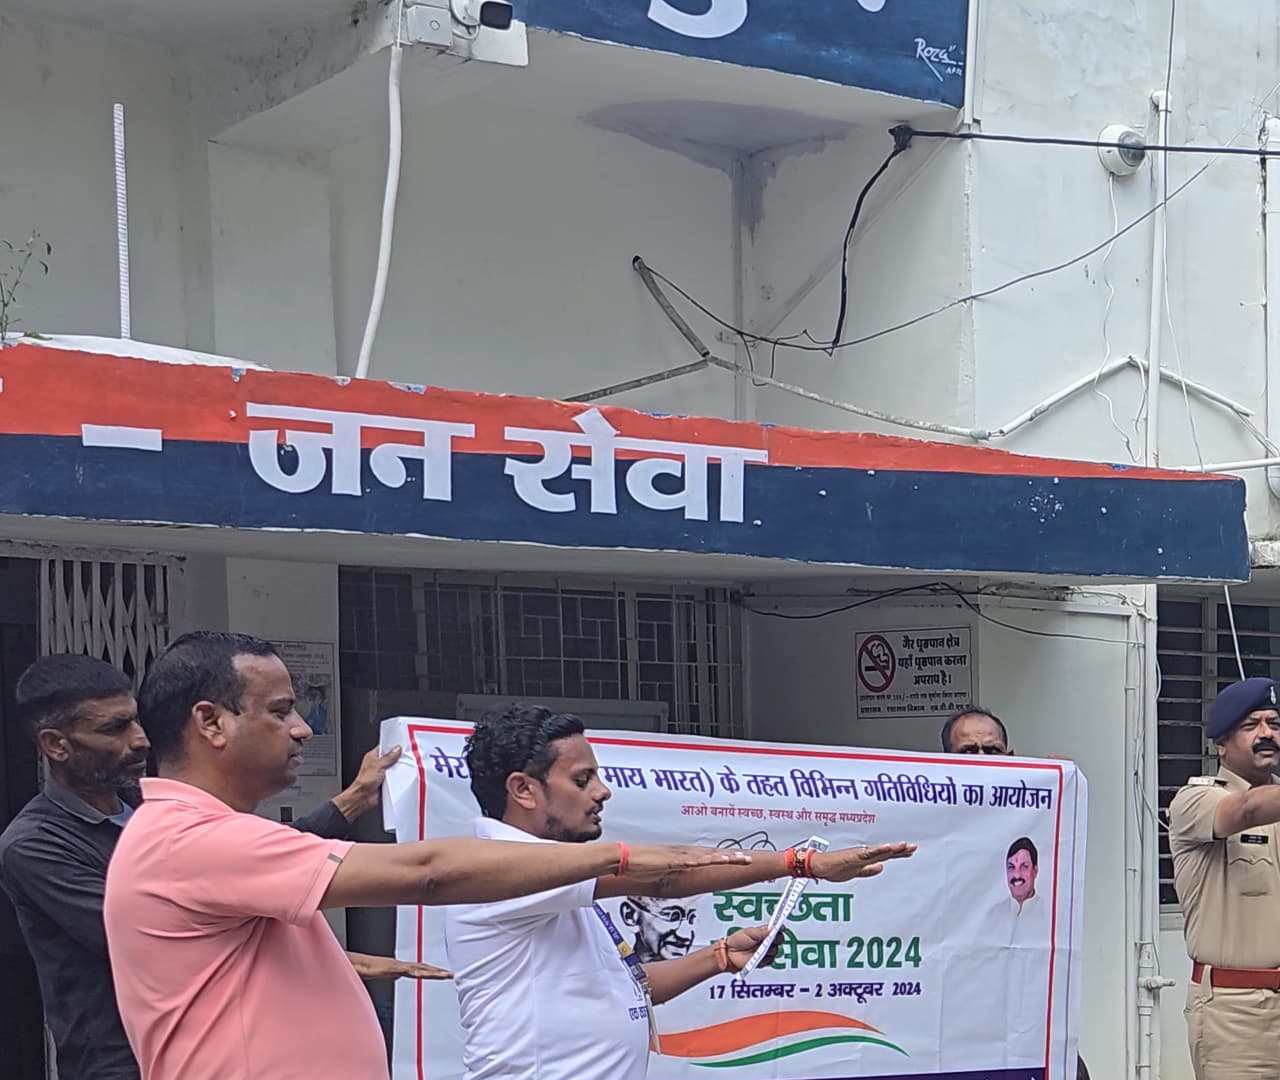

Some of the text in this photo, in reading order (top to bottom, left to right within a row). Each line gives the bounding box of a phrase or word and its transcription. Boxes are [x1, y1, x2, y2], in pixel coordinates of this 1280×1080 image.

[246, 402, 475, 501] जन
[504, 408, 769, 523] सेवा
[650, 766, 714, 797] भारत)
[716, 765, 741, 794] के
[742, 773, 789, 798] तहत
[790, 768, 859, 801] विभिन्न
[962, 783, 984, 807] का
[989, 779, 1052, 810] आयोजन
[681, 802, 707, 817] आओ
[737, 807, 767, 821] स्वच्छ,
[768, 808, 794, 821] स्वस्थ
[795, 807, 812, 821] और
[814, 810, 837, 827] समृद्ध
[839, 809, 876, 825] मध्यप्रदेश
[847, 936, 922, 969] 2024
[709, 985, 726, 1000] 17
[730, 979, 796, 1000] सितम्बर
[814, 983, 823, 998] 2
[892, 982, 922, 996] 2024
